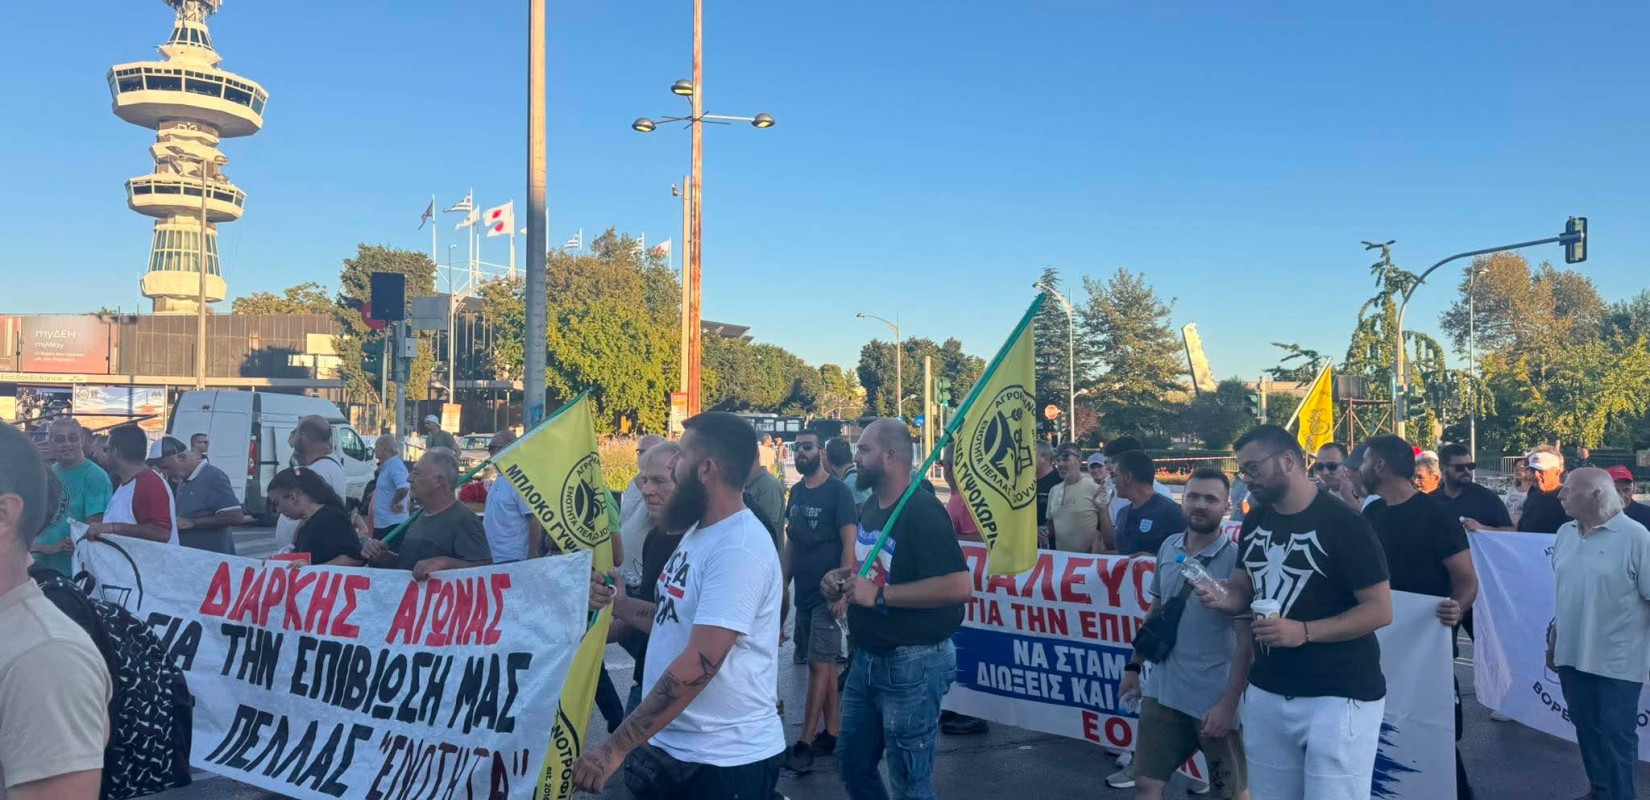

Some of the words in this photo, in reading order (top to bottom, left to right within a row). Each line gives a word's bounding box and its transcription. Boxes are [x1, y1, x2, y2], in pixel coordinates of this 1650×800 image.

[975, 420, 989, 466] ΕΝΟΤΗΤΑ
[505, 464, 555, 523] ΜΠΛΟΚΟ
[565, 486, 578, 527] ΕΝΟΤΗΤΑ
[200, 561, 371, 638] ΔΙΑΡΚΗΣ
[385, 573, 512, 647] ΑΓΩΝΑΣ
[967, 597, 1004, 627] ΓΙΑ
[1011, 603, 1069, 636] ΤΗΝ
[148, 612, 203, 671] ΓΙΑ
[221, 622, 284, 690] ΤΗΝ
[290, 636, 456, 725] ΕΠΙΒΙΩΣΗ
[447, 652, 533, 734] ΜΑΣ
[1013, 639, 1050, 670] ΝΑ
[977, 661, 1065, 701] ΔΙΩΞΕΙΣ
[1071, 676, 1115, 710] ΚΑΙ
[204, 703, 374, 798] ΠΕΛΛΑΣ
